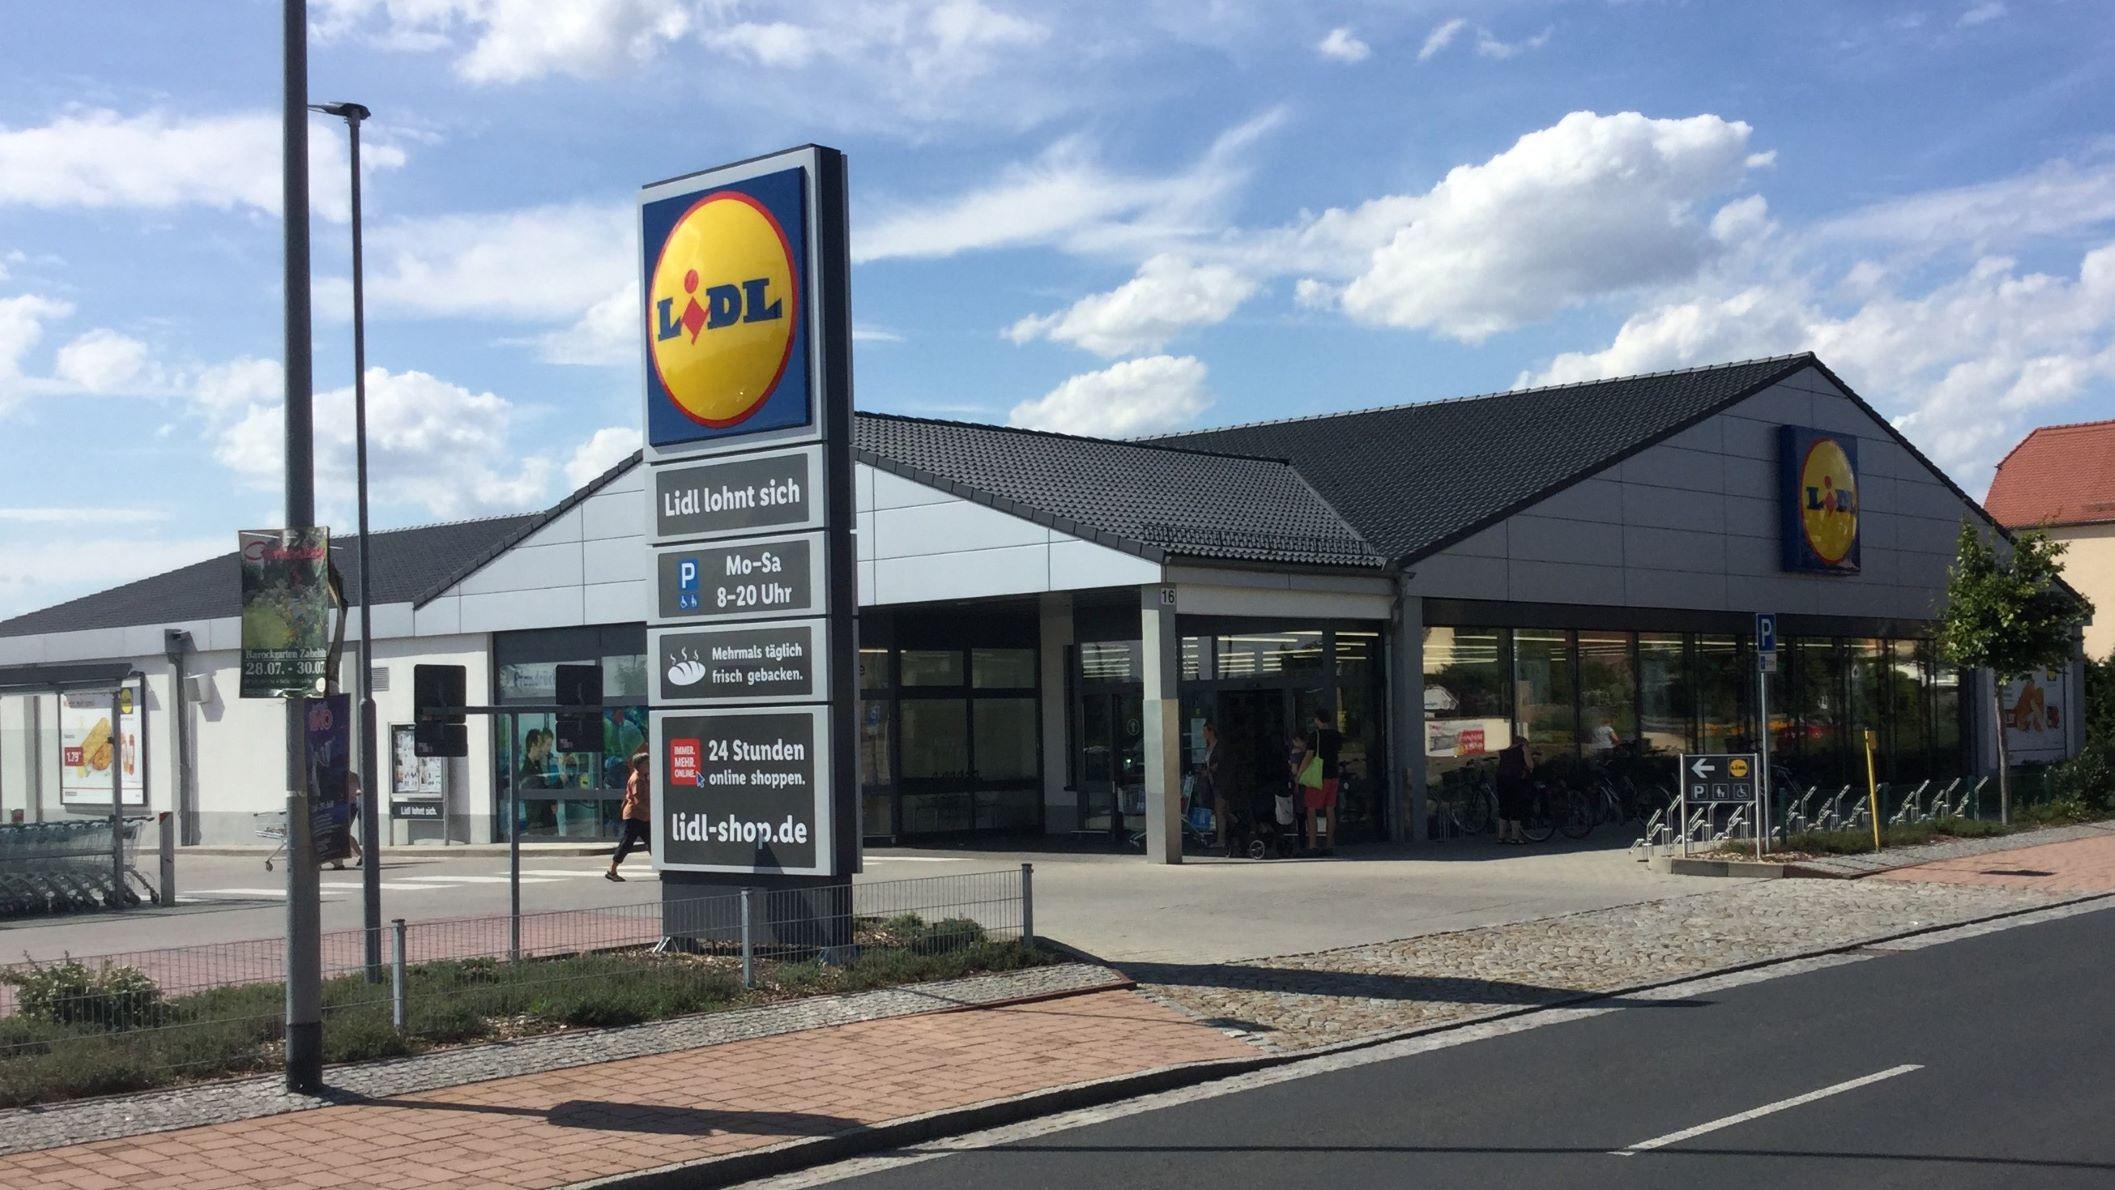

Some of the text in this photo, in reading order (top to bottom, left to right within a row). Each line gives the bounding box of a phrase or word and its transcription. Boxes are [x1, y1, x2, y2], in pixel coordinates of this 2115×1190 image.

[665, 478, 800, 517] Lidl lohnt sich
[726, 552, 782, 576] Mo-Sa
[681, 562, 695, 589] P
[717, 583, 792, 608] 8-20 Uhr
[1161, 589, 1175, 604] 16
[1760, 618, 1772, 647] P
[712, 643, 802, 662] Mehrmals täglich
[246, 662, 285, 676] 28.07.
[712, 667, 803, 686] frisch gebacken.
[674, 745, 696, 755] IMMER.
[709, 738, 804, 761] 24 Stunden
[674, 757, 696, 768] MEHR.
[709, 769, 805, 789] online shoppen.
[1694, 785, 1704, 799] P
[672, 812, 807, 849] lidl-shop.de
